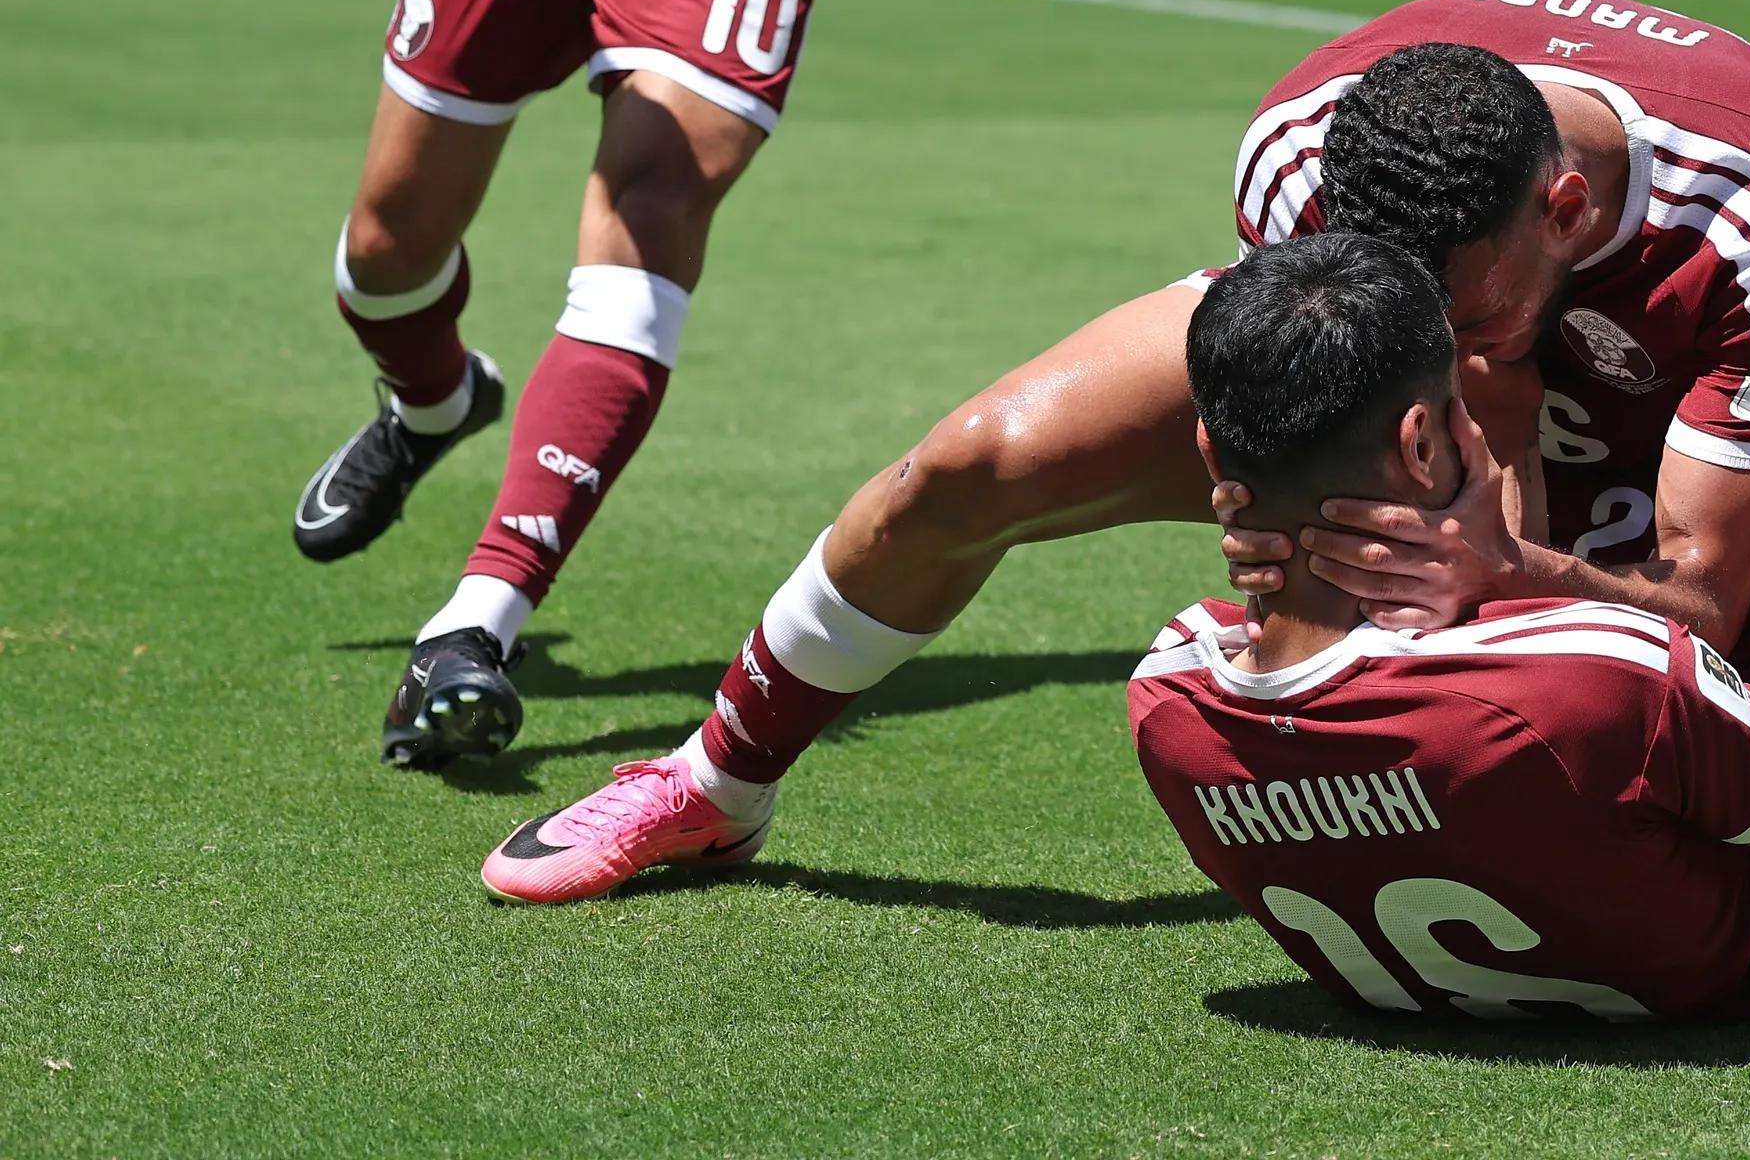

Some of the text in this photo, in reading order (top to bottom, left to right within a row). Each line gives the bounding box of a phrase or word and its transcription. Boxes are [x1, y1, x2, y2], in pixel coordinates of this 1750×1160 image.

[1594, 360, 1638, 380] QFA
[537, 443, 602, 495] QFA
[1195, 767, 1441, 846] KHOUKHI
[1262, 878, 1656, 1023] 16
